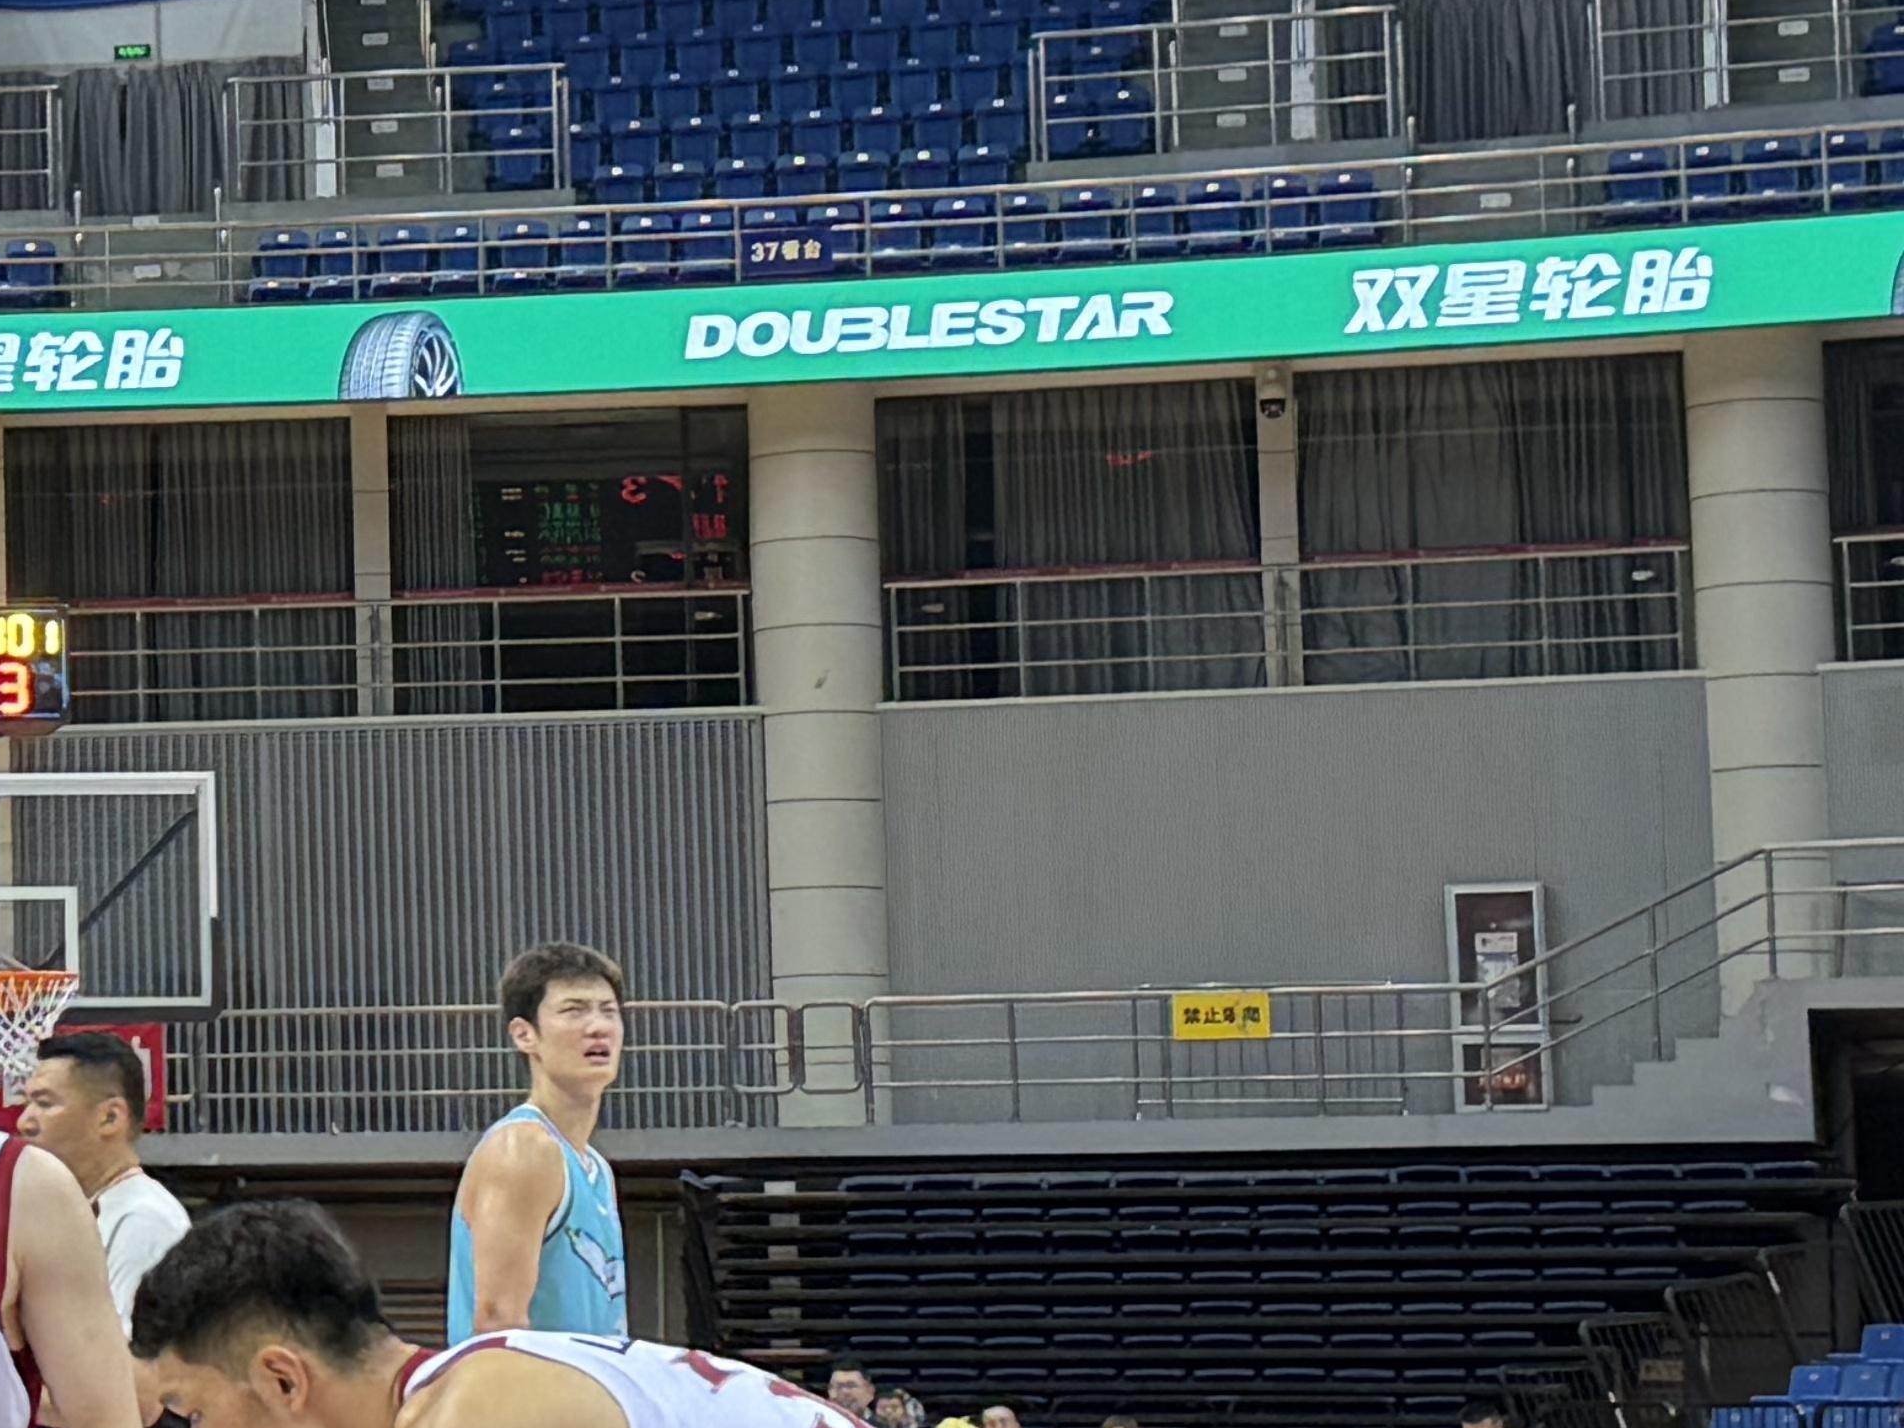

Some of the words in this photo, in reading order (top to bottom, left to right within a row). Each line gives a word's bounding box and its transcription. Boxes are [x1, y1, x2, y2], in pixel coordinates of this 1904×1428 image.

[685, 290, 1174, 360] DOUBLESTAR
[1344, 246, 1713, 333] 双星轮胎
